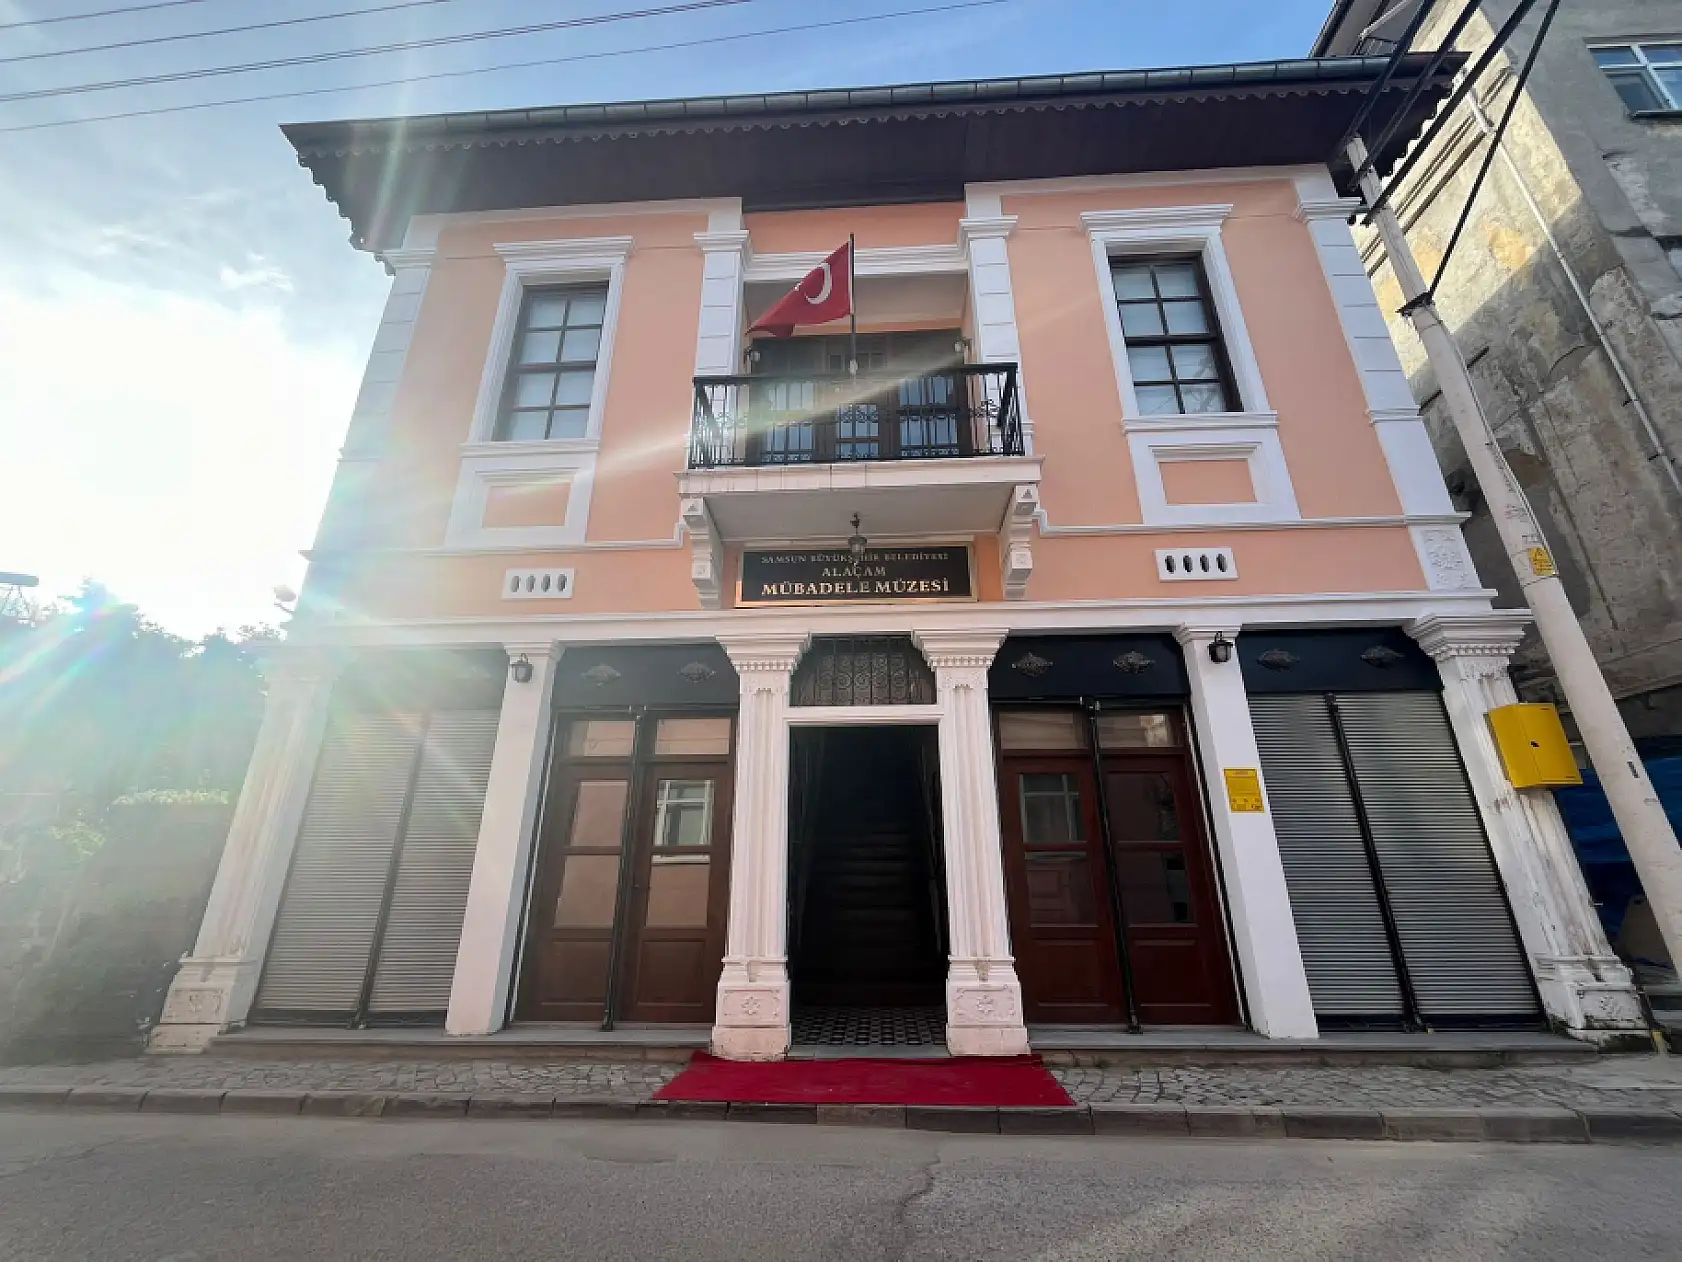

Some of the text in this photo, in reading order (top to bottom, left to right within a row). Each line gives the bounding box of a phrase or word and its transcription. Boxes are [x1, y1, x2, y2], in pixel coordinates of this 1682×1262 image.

[761, 555, 807, 564] SAMSUN
[822, 566, 886, 579] ALAÇAM
[761, 577, 949, 596] MÜBADELE MÜZESİ
